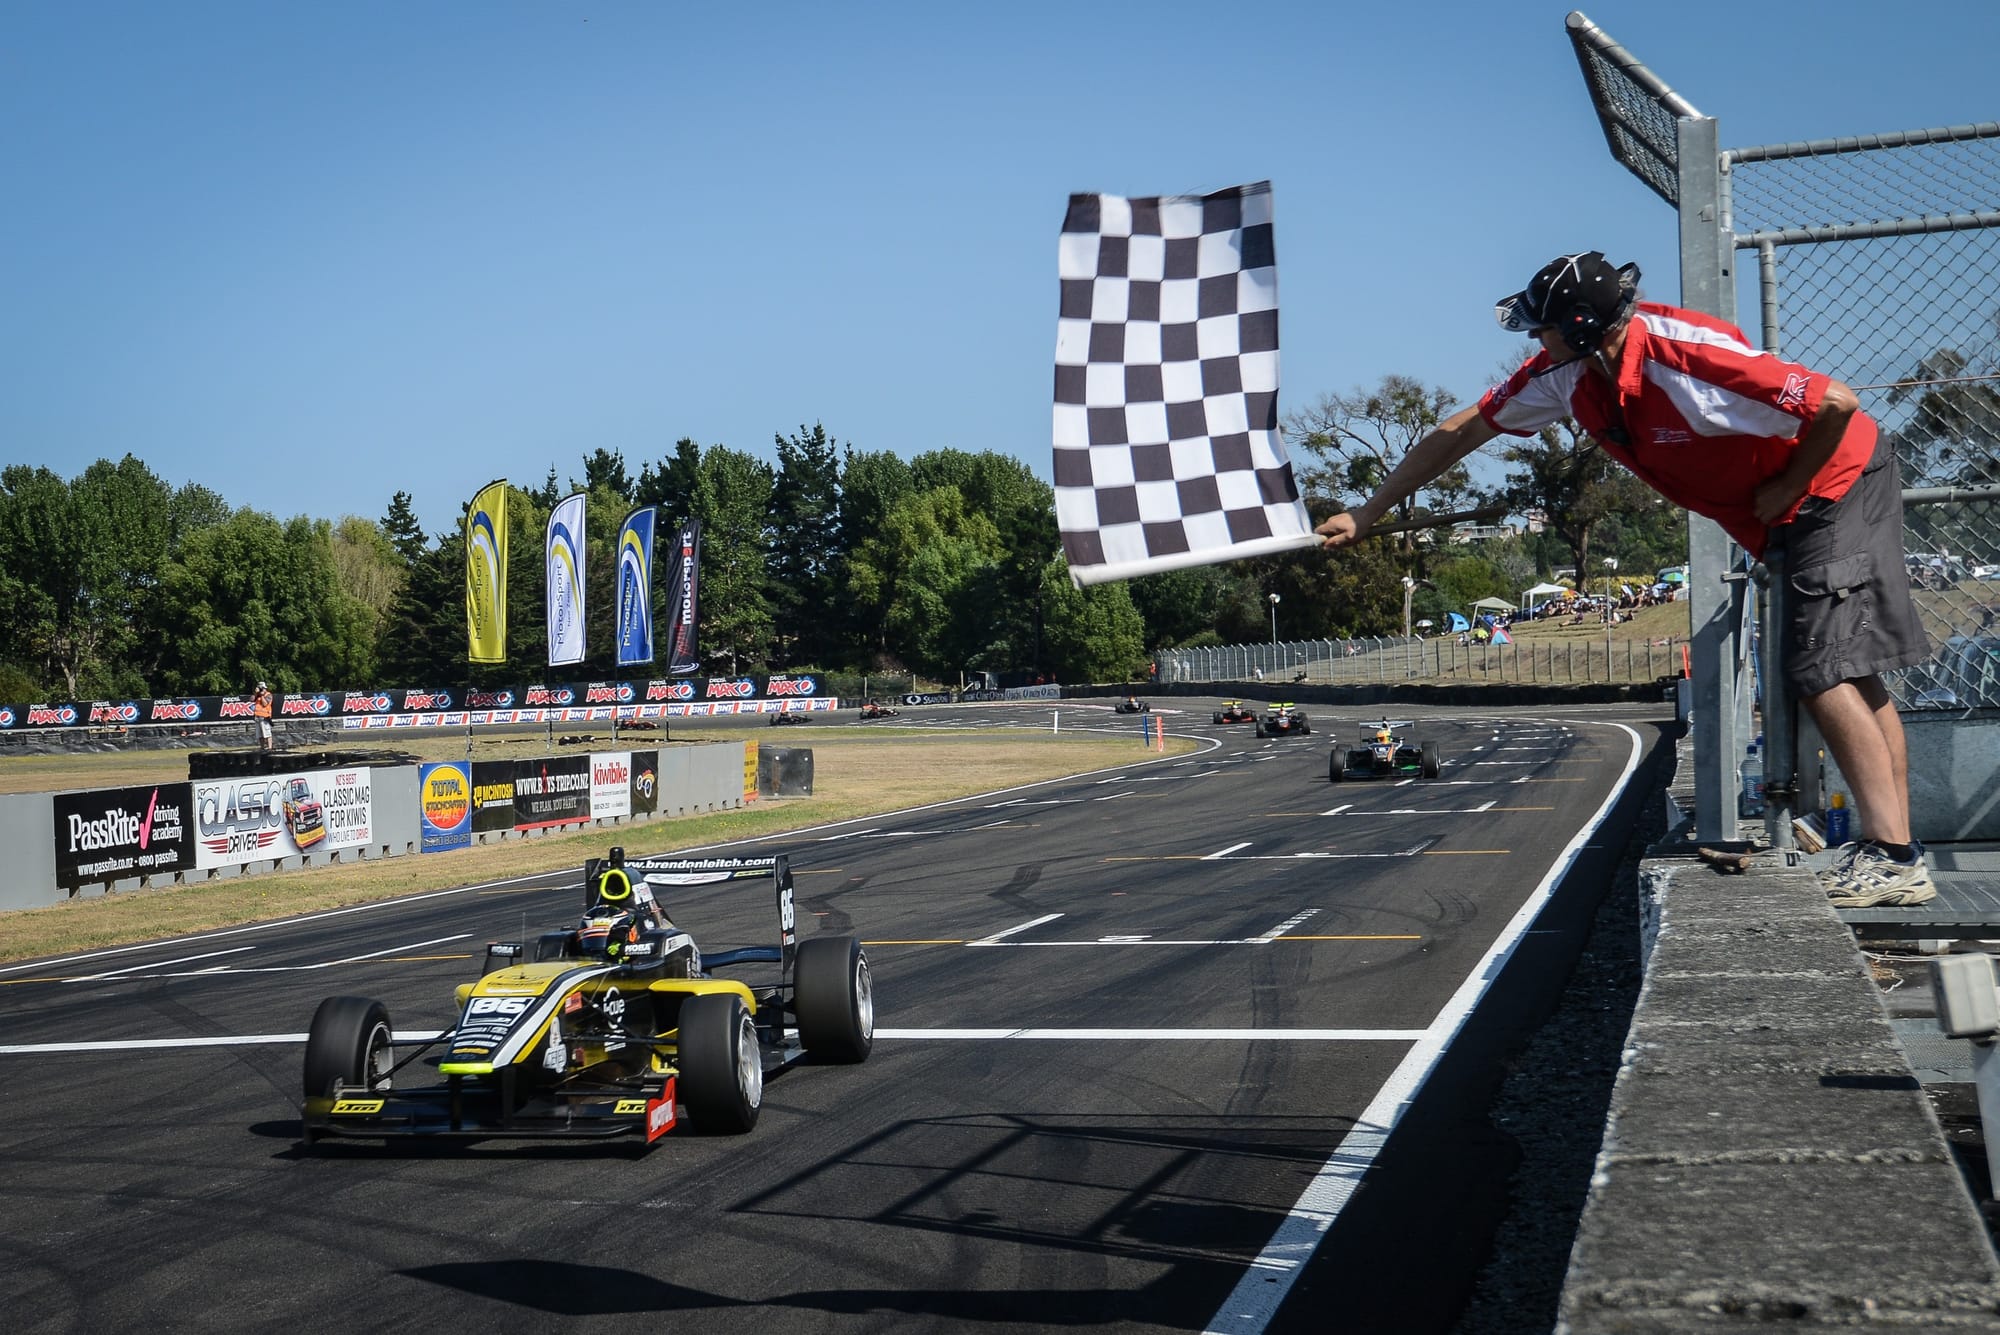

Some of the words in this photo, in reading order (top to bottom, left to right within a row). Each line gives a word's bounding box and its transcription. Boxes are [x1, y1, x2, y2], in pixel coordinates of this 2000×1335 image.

[556, 563, 564, 645] MotorSport
[586, 687, 617, 702] MAX
[646, 684, 679, 700] MAX
[706, 682, 739, 698] MAX
[767, 680, 800, 696] MAX
[343, 696, 378, 712] MAX
[404, 694, 437, 710] MAX
[465, 692, 499, 706] MAX
[526, 690, 559, 705] MAX
[790, 700, 807, 710] BNT
[813, 700, 830, 710] BNT
[151, 704, 185, 720] MAX
[220, 702, 255, 717] MAX
[282, 700, 316, 715] MAX
[594, 708, 611, 719] BNT
[619, 707, 636, 718] BNT
[643, 706, 660, 716] BNT
[692, 704, 709, 714] BNT
[716, 702, 733, 713] BNT
[740, 702, 758, 712] BNT
[765, 701, 782, 711] BNT
[27, 708, 62, 724] MAX
[370, 717, 387, 727] BNT
[394, 716, 412, 726] BNT
[420, 715, 438, 726] BNT
[445, 714, 462, 724] BNT
[495, 712, 512, 723] BNT
[520, 711, 536, 722] BNT
[569, 709, 586, 720] BNT
[346, 773, 357, 784] BEST
[594, 762, 627, 786] kiwibike
[431, 779, 462, 797] TOTAL
[483, 783, 513, 800] MCINTOSH
[323, 787, 354, 808] CLASSIC
[355, 786, 370, 804] MAG
[200, 780, 282, 837] CLASSIC
[531, 801, 539, 813] WE
[553, 799, 562, 810] YOU
[154, 805, 179, 825] driving
[330, 810, 345, 829] FOR
[346, 807, 367, 826] KIWIS
[68, 808, 140, 852] PassRite
[152, 823, 182, 842] academy
[228, 832, 258, 854] DRIVER
[78, 857, 133, 876] www.passrite.co.nz
[139, 854, 154, 866] 0800
[155, 848, 178, 867] passrite
[781, 888, 795, 931] 86
[471, 998, 526, 1014] 86
